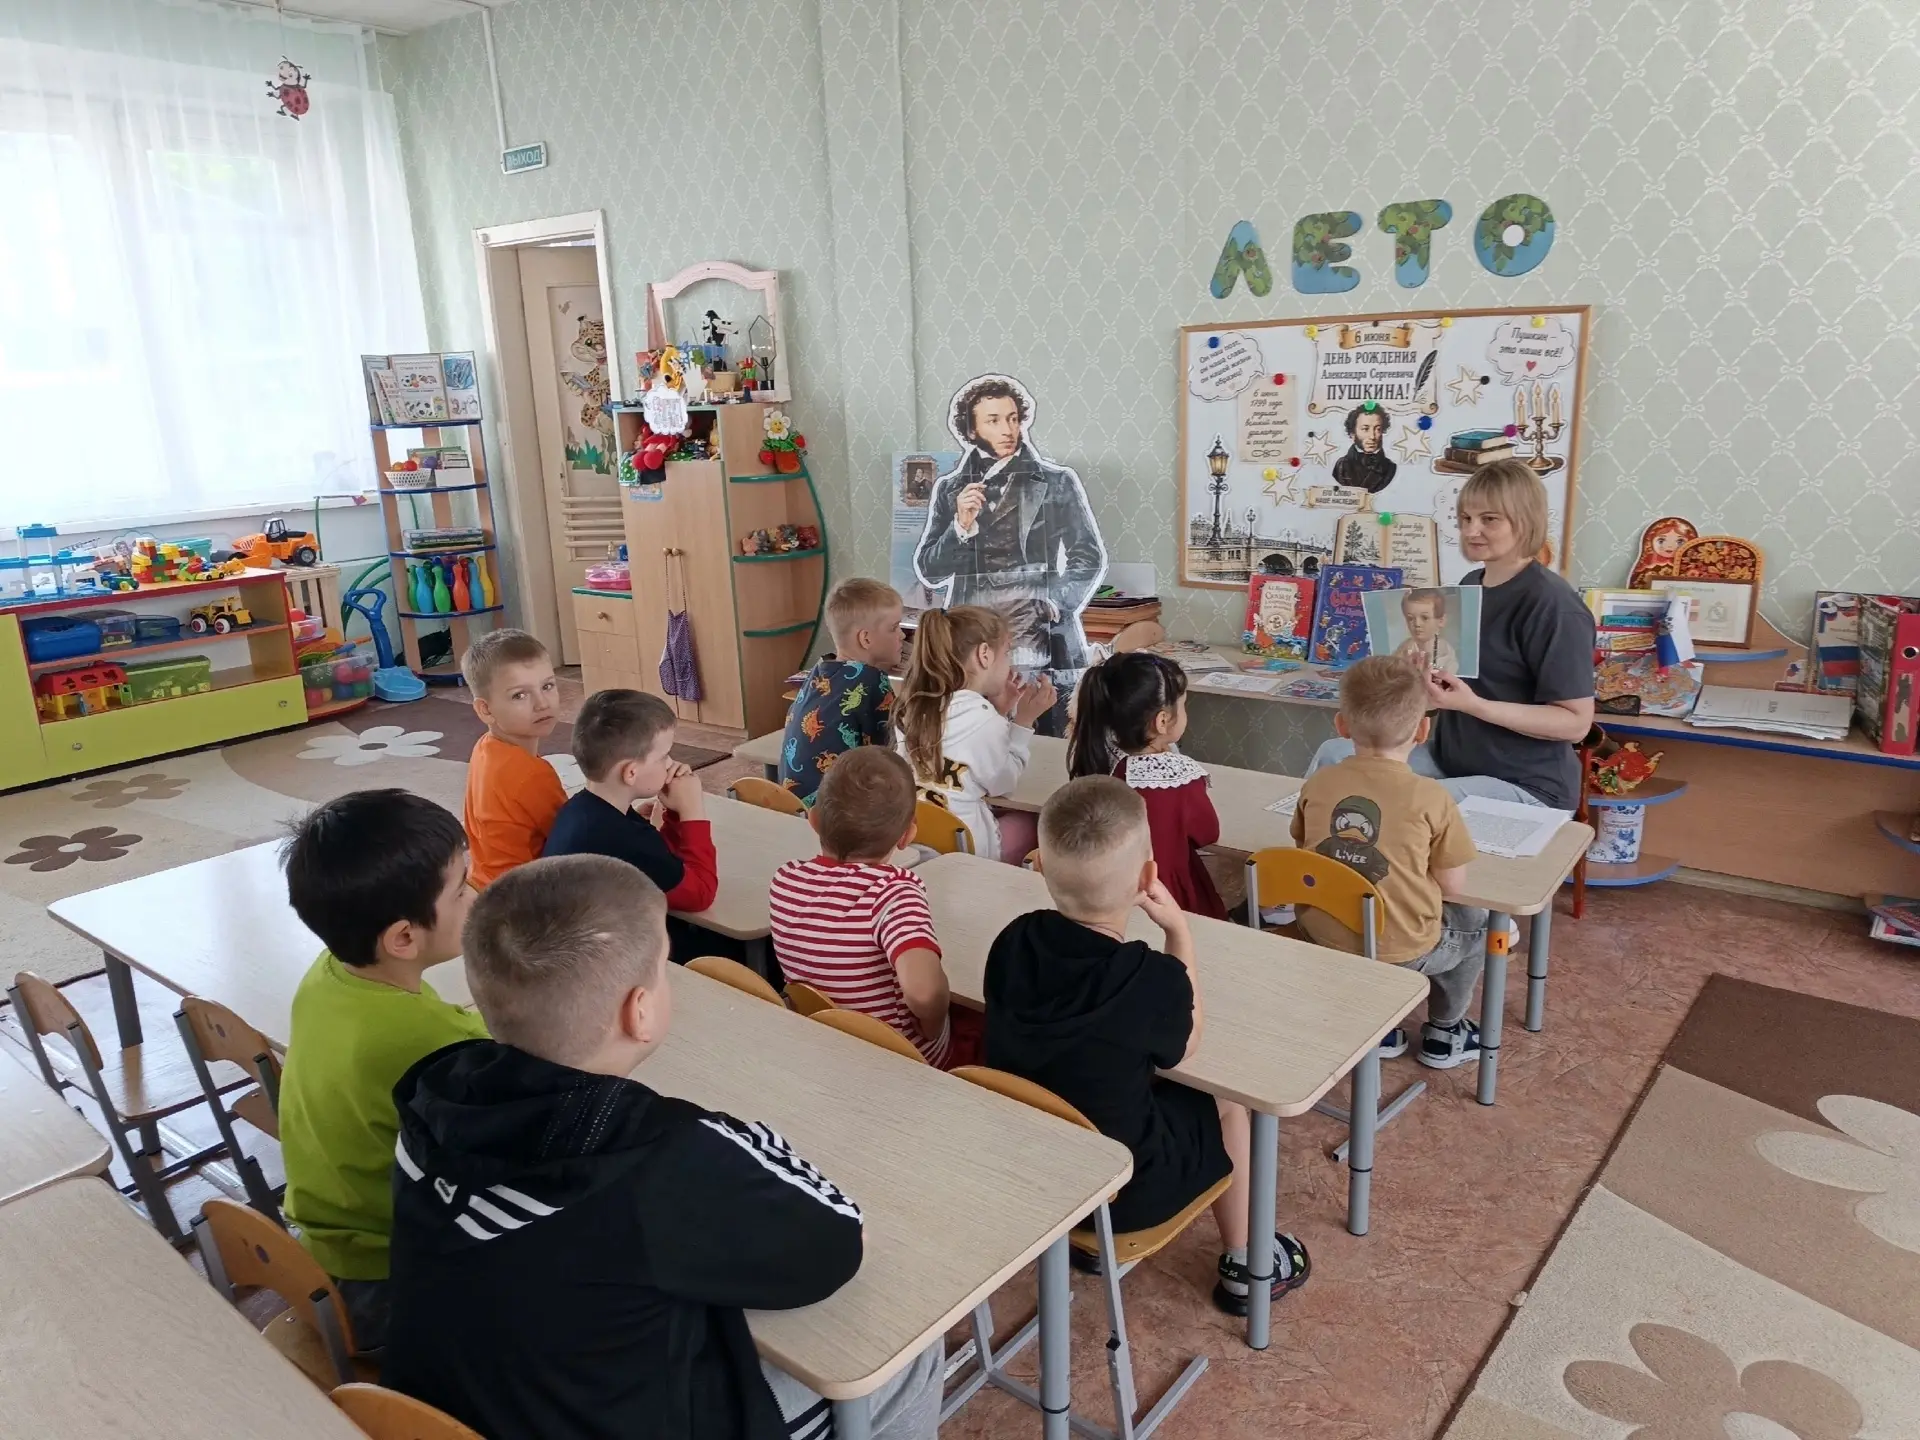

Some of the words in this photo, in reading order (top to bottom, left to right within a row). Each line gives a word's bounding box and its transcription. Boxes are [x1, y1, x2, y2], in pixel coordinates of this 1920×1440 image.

[506, 149, 541, 167] ВЫХОД
[1209, 193, 1555, 300] ЛЕТО
[1354, 330, 1362, 344] 6
[1363, 333, 1391, 342] июня
[1323, 352, 1352, 366] ДЕНЬ
[1355, 351, 1418, 365] РОЖДЕНИЯ
[1321, 369, 1368, 381] Александра
[1369, 368, 1415, 381] Сергеевича
[1326, 382, 1411, 400] ПУШКИНА!
[1496, 938, 1503, 949] 1
